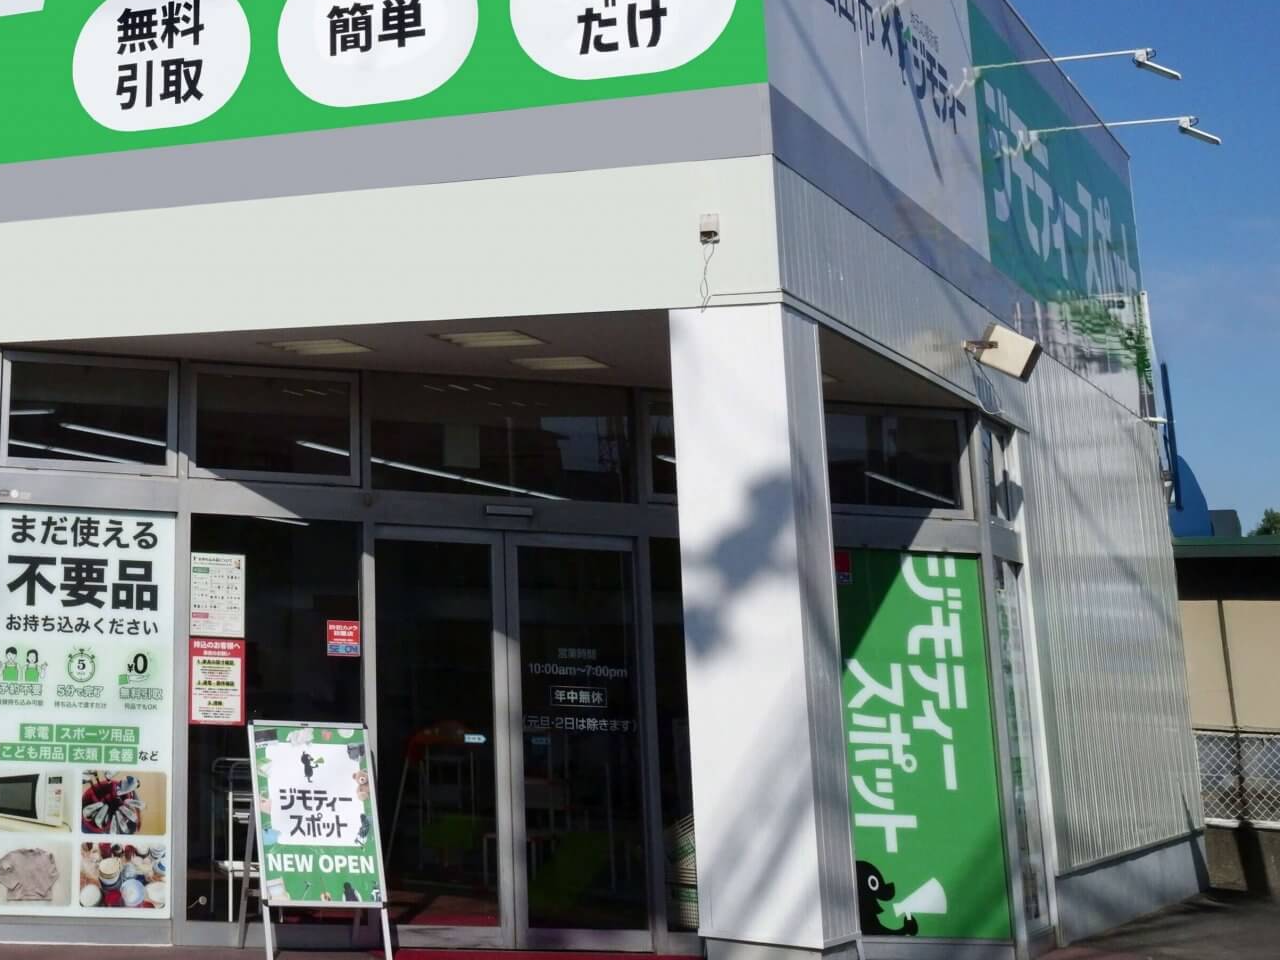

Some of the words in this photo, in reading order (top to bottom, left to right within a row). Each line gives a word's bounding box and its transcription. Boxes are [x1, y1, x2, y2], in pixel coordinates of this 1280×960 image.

[116, 57, 204, 110] 引取
[11, 515, 158, 550] まだ使える
[6, 555, 158, 611] 不要品
[6, 613, 159, 635] お持ち込みください
[901, 554, 968, 791] ジモティー
[554, 689, 603, 704] 年中無休
[24, 726, 49, 740] 家電
[60, 727, 135, 743] スポーツ用品
[1, 746, 65, 760] こども用品
[72, 747, 98, 761] 衣類
[108, 748, 134, 763] 食器
[846, 659, 918, 853] スポット
[279, 788, 352, 811] ジモティー
[289, 813, 348, 838] スポット
[267, 853, 313, 872] NEW
[319, 854, 375, 874] OPEN
